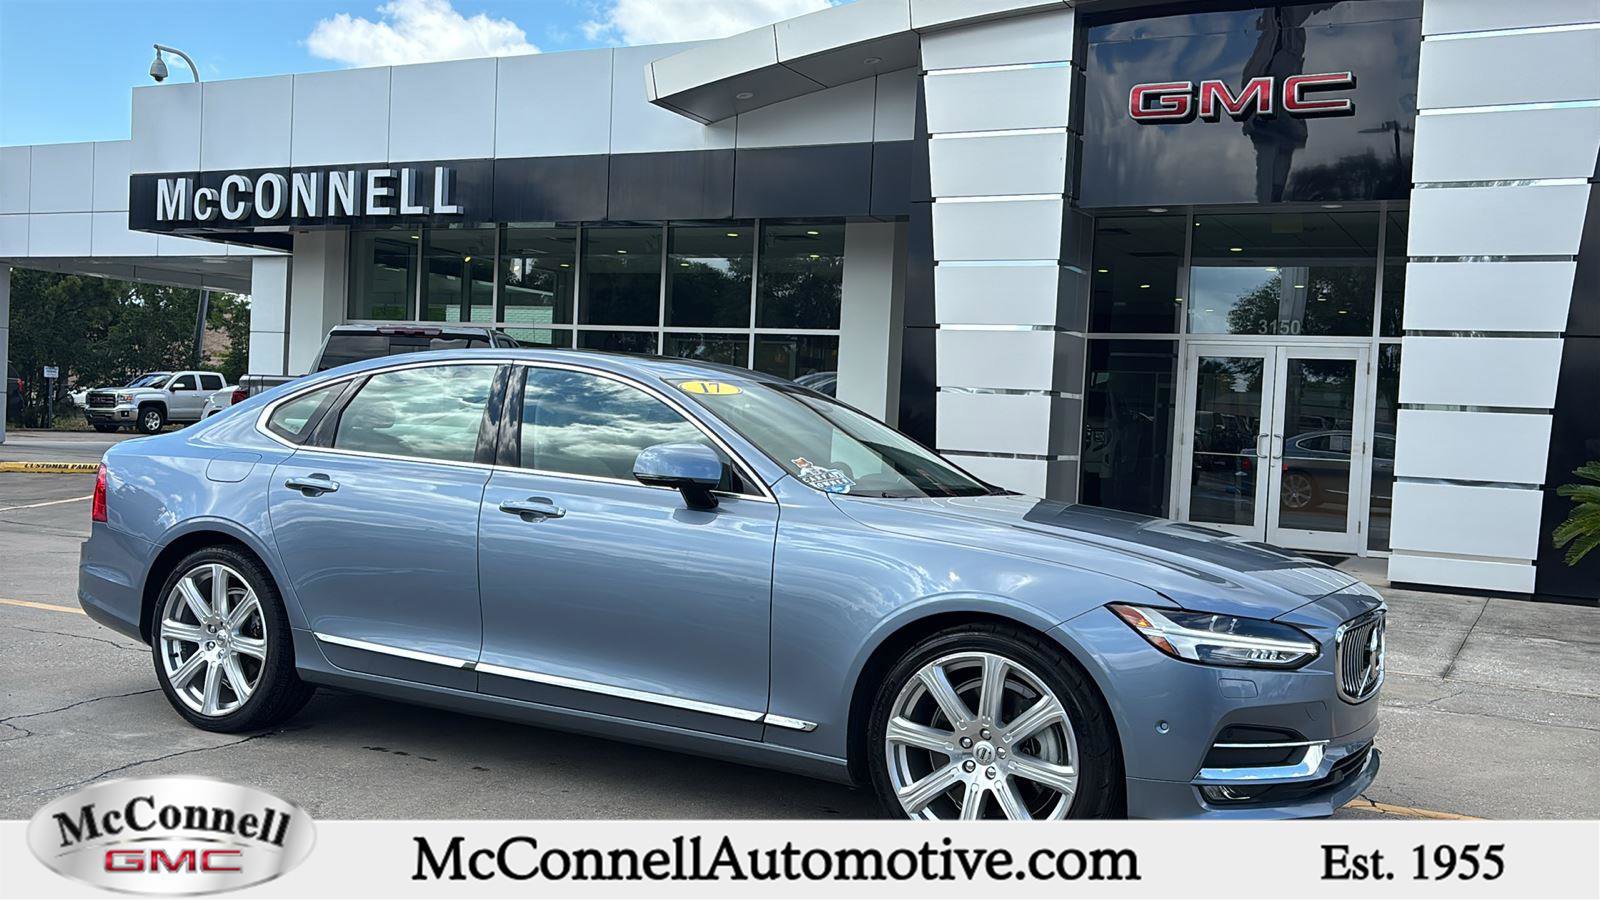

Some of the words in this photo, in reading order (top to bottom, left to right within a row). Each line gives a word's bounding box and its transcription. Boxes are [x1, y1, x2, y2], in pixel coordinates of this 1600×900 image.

[1129, 71, 1354, 121] GMC
[1258, 319, 1301, 335] 3150
[700, 382, 720, 393] 17
